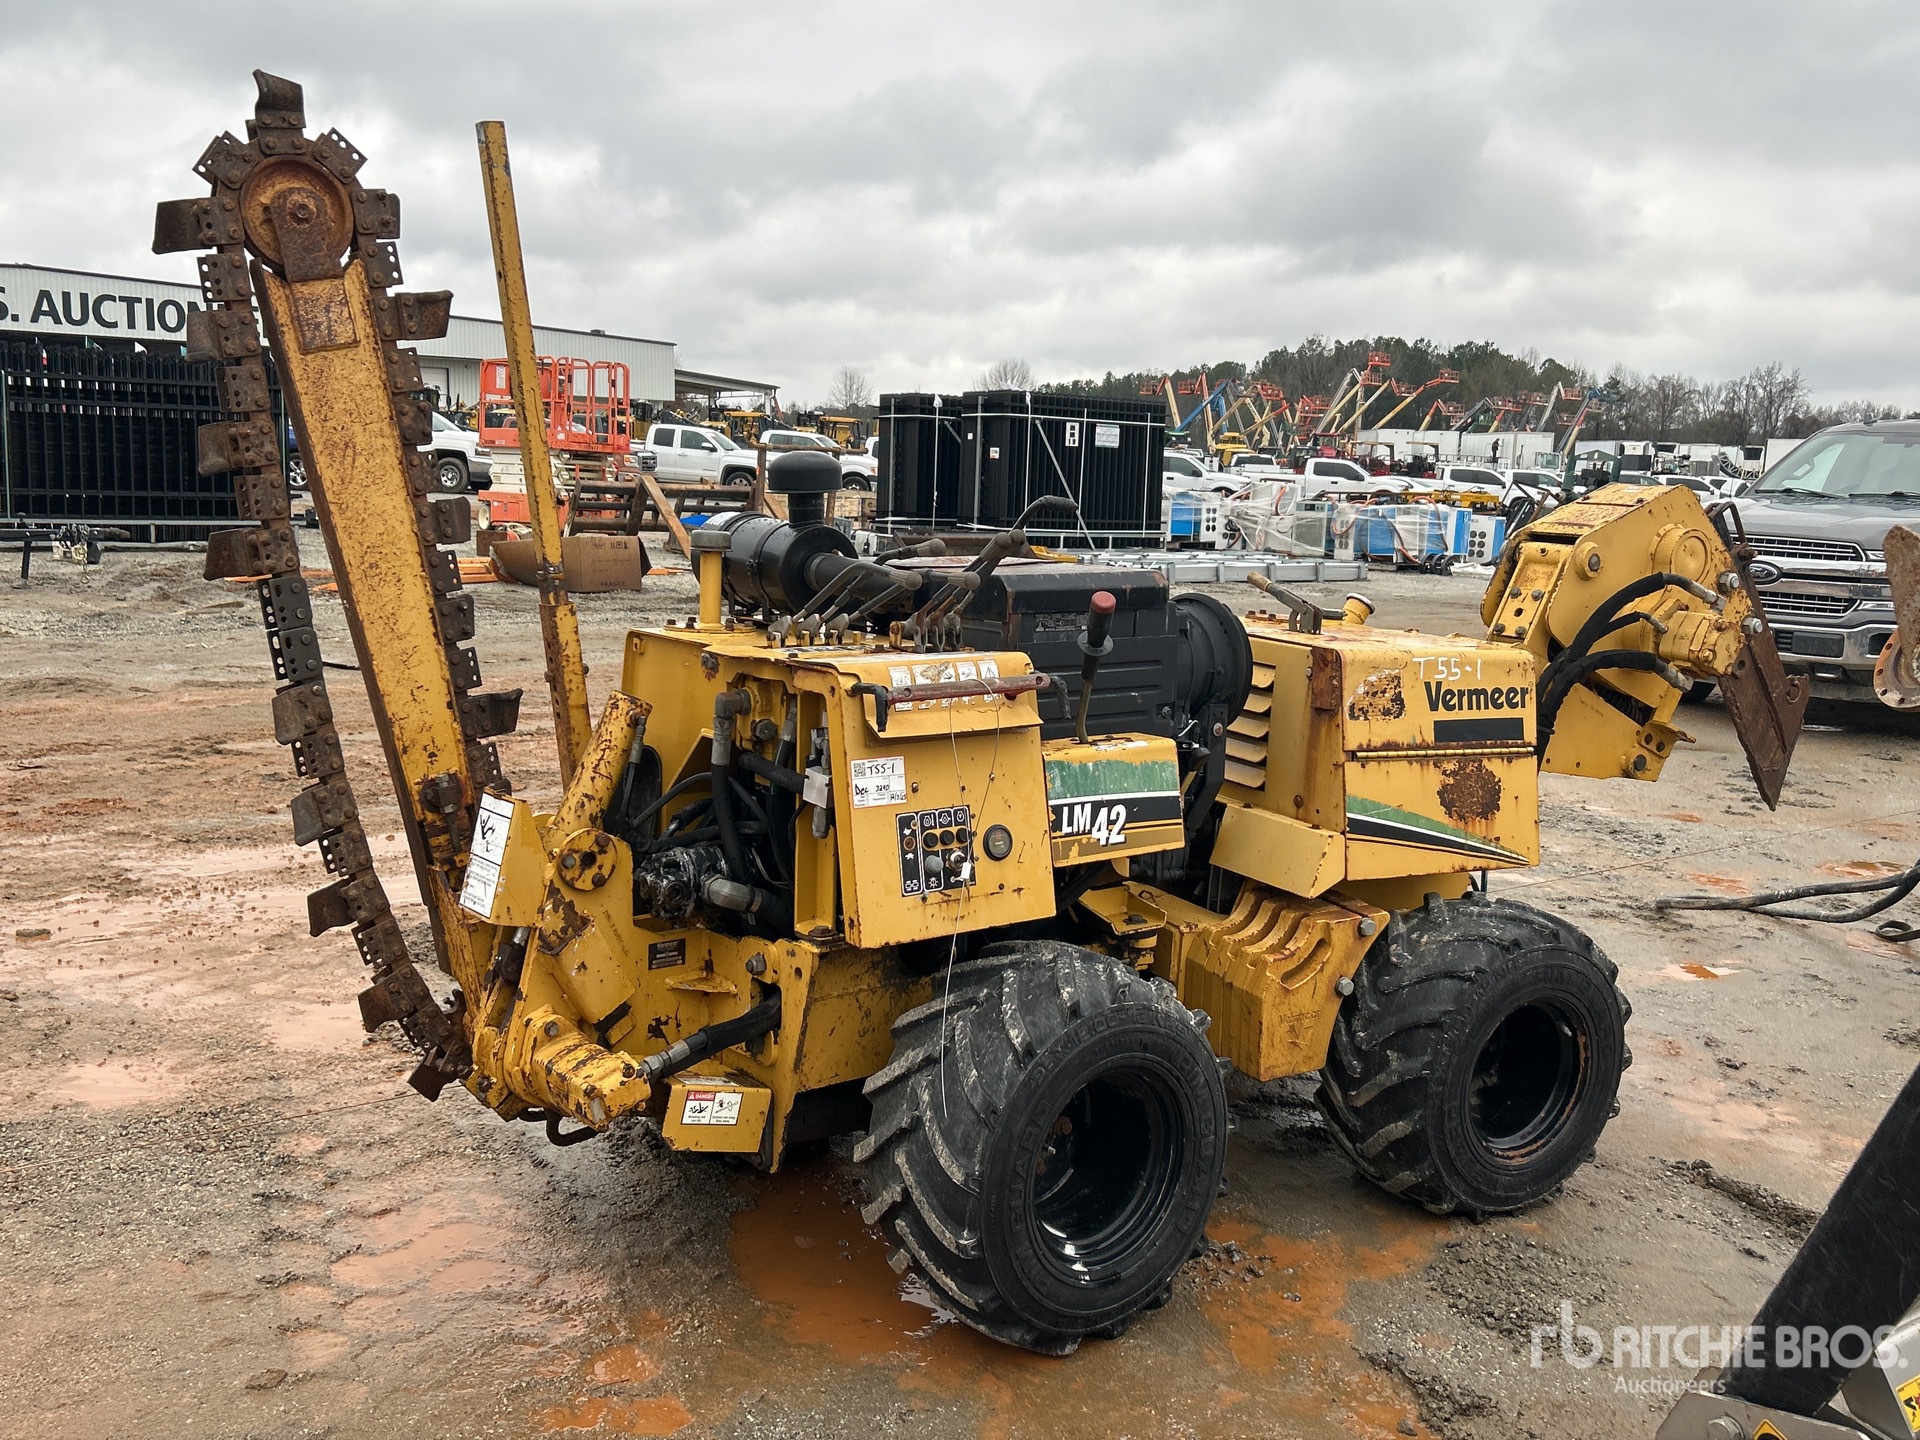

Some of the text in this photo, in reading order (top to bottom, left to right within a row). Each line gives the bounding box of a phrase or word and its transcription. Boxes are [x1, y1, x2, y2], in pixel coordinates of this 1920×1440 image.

[600, 580, 626, 588] FRAGILE
[1424, 681, 1529, 712] Vermeer
[867, 762, 895, 775] T55-1
